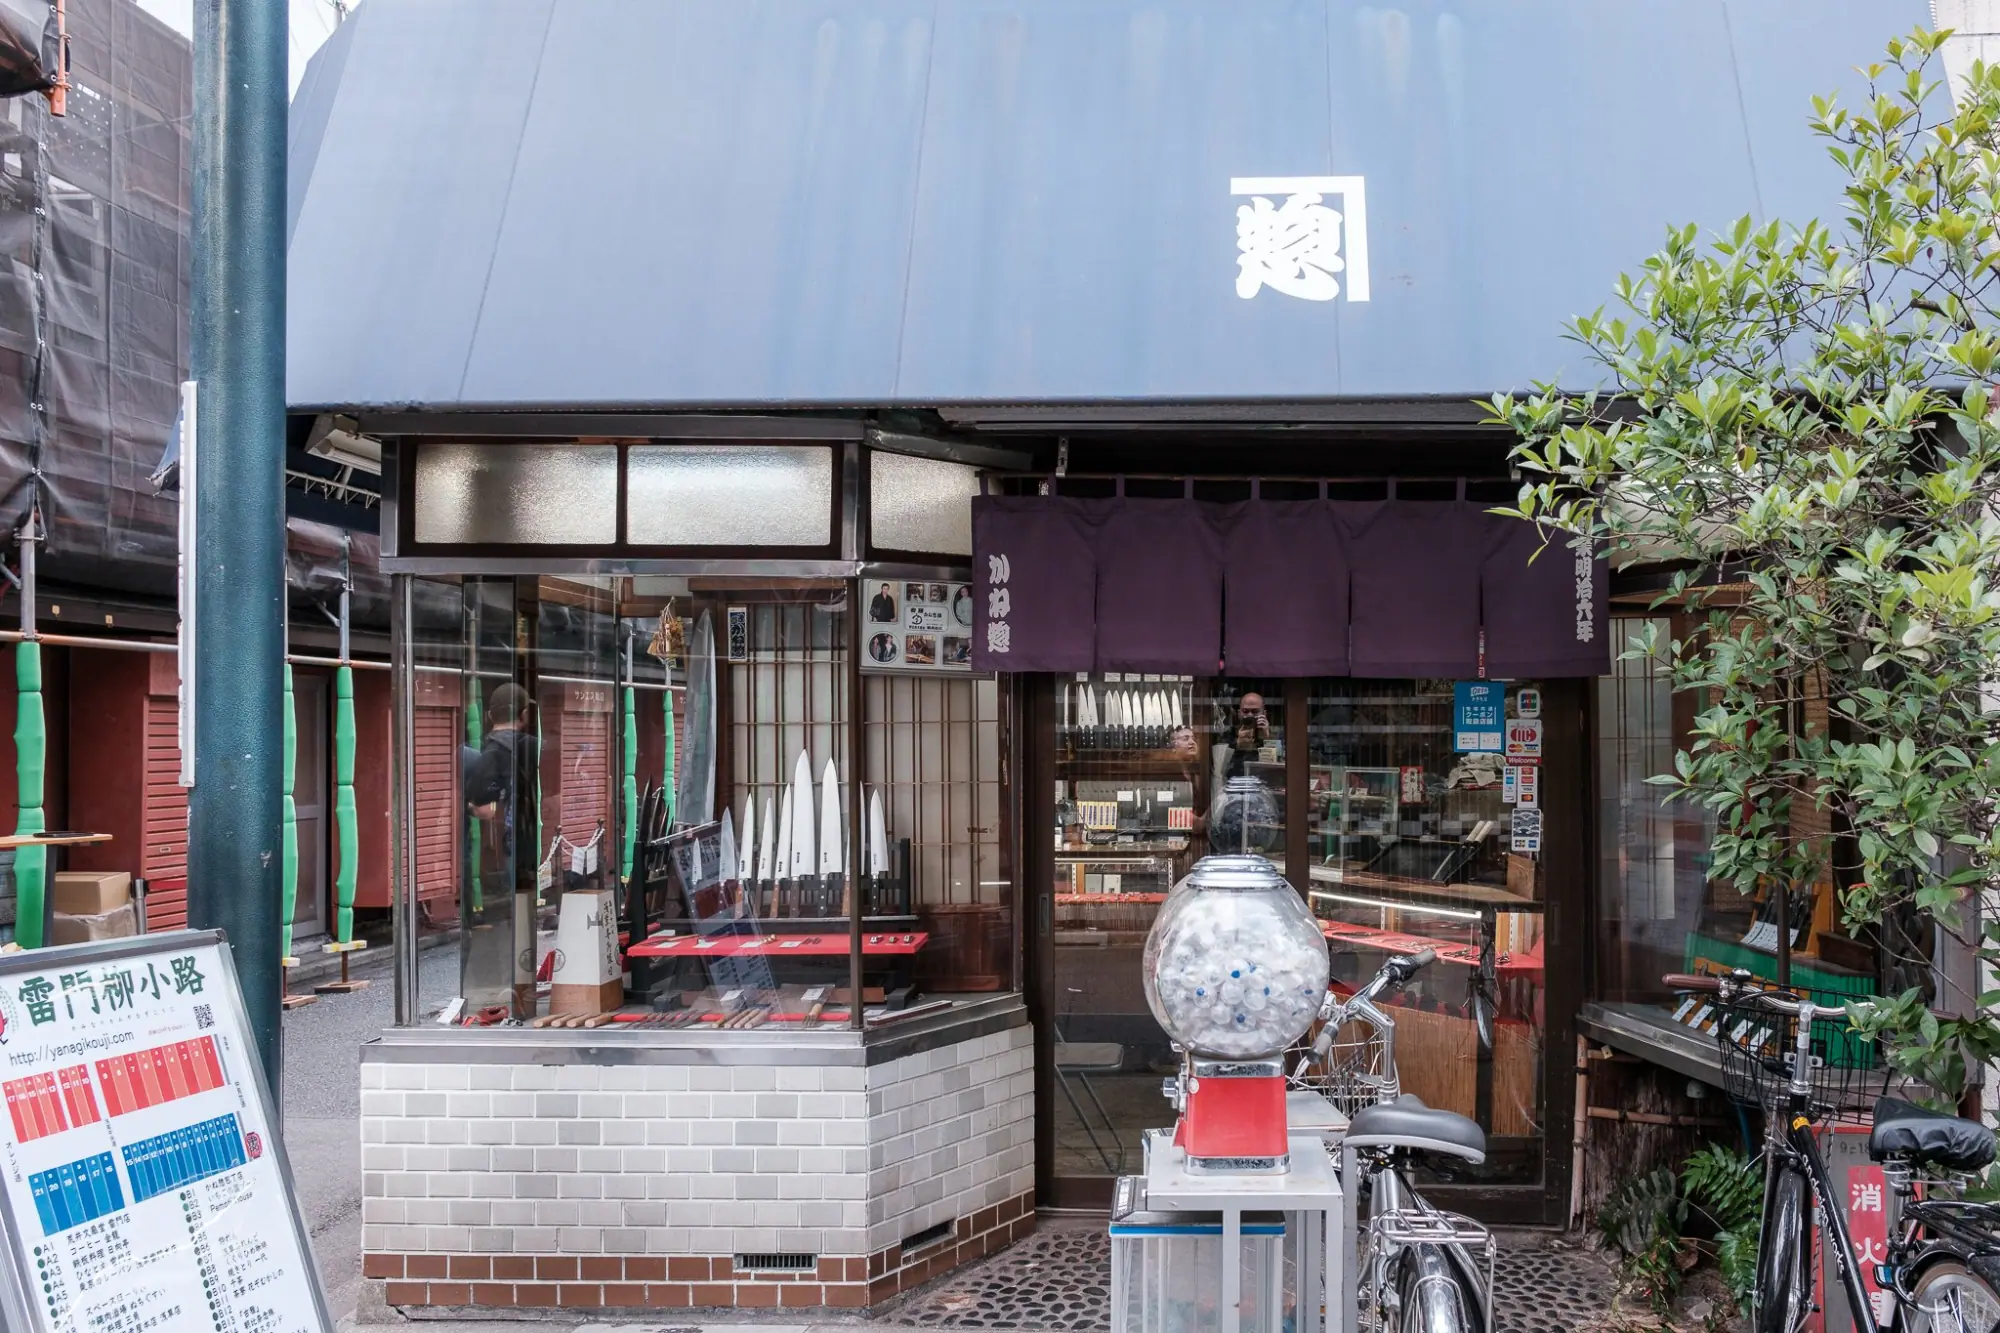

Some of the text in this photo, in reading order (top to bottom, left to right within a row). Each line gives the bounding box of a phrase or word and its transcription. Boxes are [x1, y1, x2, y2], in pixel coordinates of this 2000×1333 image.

[987, 553, 1010, 652] かね惣
[18, 955, 206, 1027] 雷門柳小路
[9, 1030, 135, 1067] http://yanagikouji.com
[186, 1189, 196, 1198] B1
[189, 1199, 200, 1209] B2
[192, 1210, 202, 1221] B3
[197, 1231, 208, 1242] B5
[43, 1242, 55, 1253] A1
[200, 1242, 211, 1253] B6
[46, 1253, 59, 1265] A2
[203, 1253, 213, 1264] B7
[50, 1265, 62, 1277] A3
[206, 1264, 217, 1275] B8
[53, 1279, 65, 1290] A4
[209, 1274, 219, 1285] B9
[56, 1290, 68, 1302] A5
[212, 1284, 227, 1297] B10
[215, 1294, 229, 1308] B11
[60, 1303, 71, 1314] A6
[218, 1305, 233, 1318] B12
[221, 1316, 236, 1329] B13
